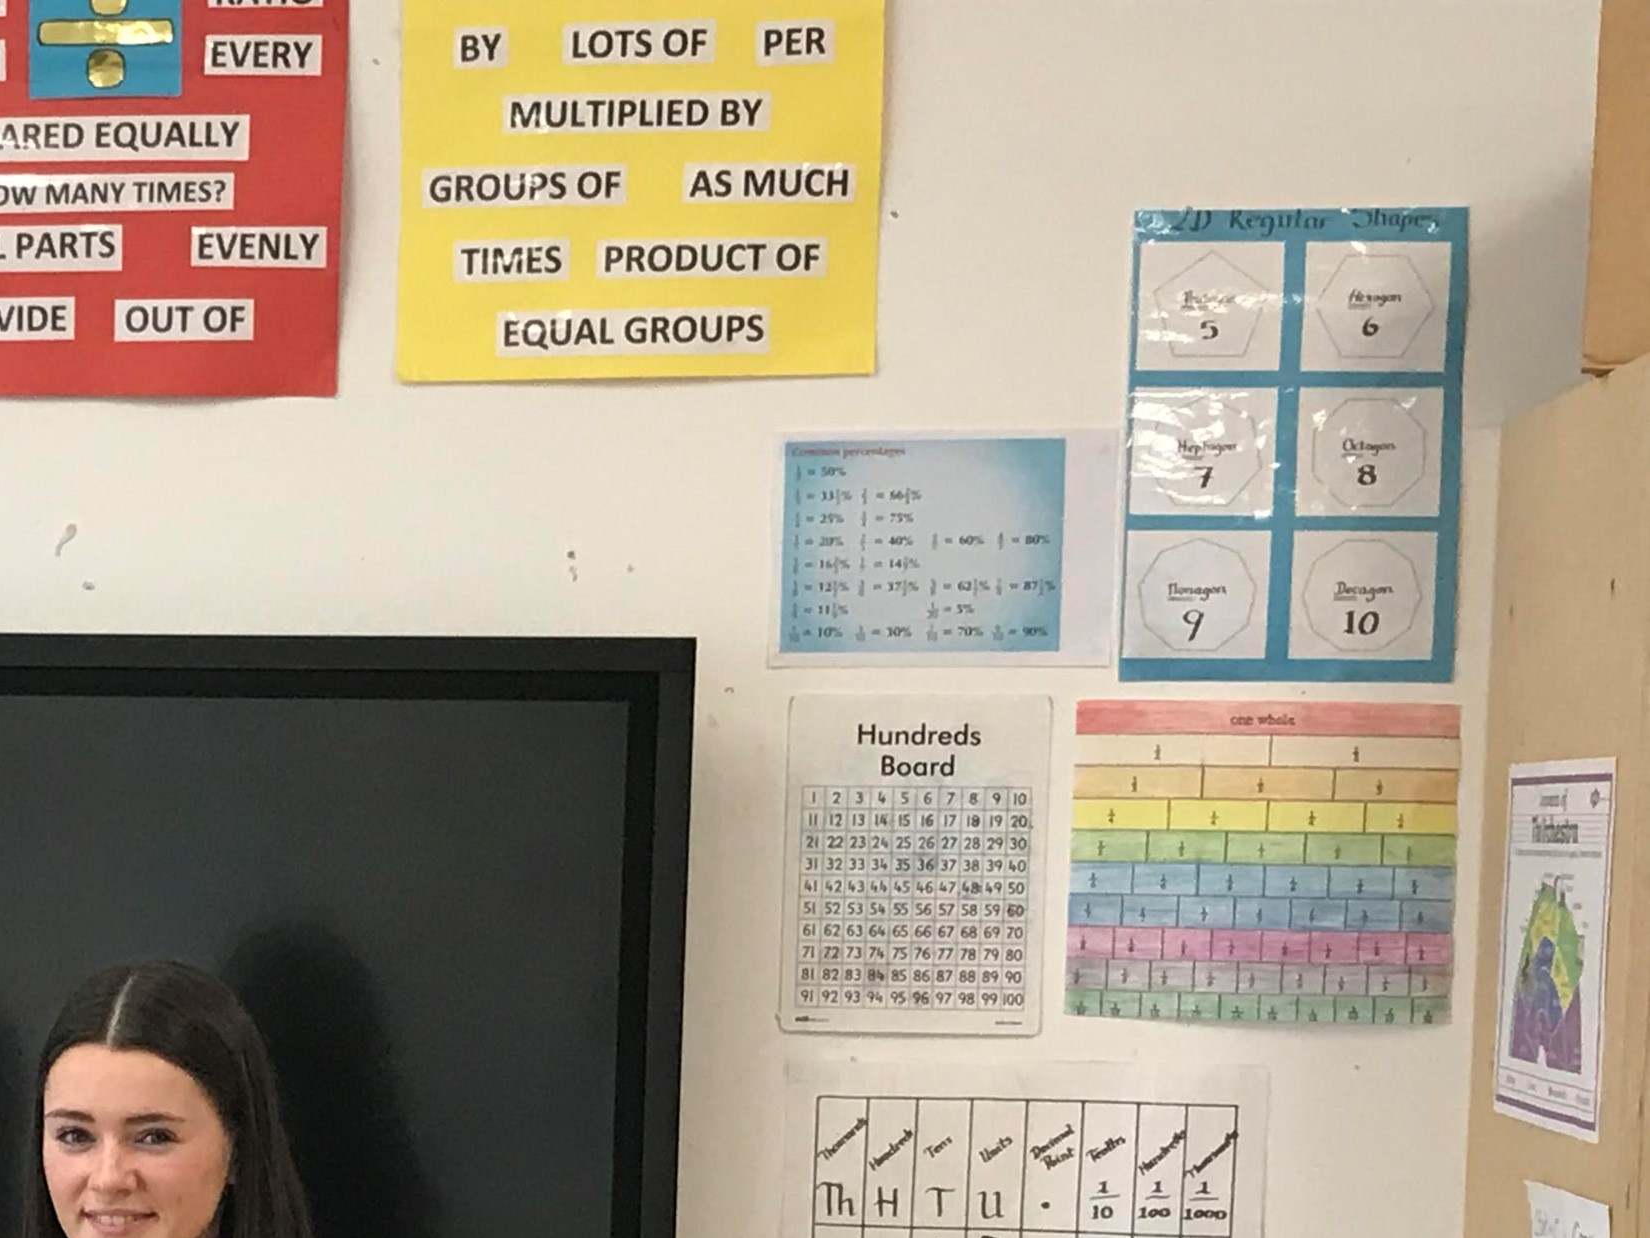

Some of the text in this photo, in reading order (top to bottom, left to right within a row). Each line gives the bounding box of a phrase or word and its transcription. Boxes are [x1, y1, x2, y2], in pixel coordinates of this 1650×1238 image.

[460, 33, 502, 62] BY
[571, 29, 707, 59] LOTS OF
[763, 27, 826, 55] PER
[210, 41, 313, 69] EVERY
[509, 98, 763, 128] MULTIPLIED BY
[94, 120, 240, 152] EQUALLY
[45, 183, 126, 205] MANY
[133, 180, 226, 202] TIMES?
[429, 172, 621, 202] GROUPS OF
[689, 170, 849, 197] AS MUCH
[1172, 206, 1212, 231] 2D
[1229, 209, 1330, 236] Regular
[15, 232, 116, 259] PARTS
[198, 234, 319, 260] EVENLY
[604, 244, 821, 273] PRODUCT OF
[461, 247, 562, 276] TIMES
[125, 306, 247, 333] OUT OF
[503, 315, 765, 349] EQUAL GROUPS
[1200, 320, 1219, 340] 5
[1362, 316, 1379, 337] 6
[1342, 439, 1396, 456] Octagon
[1193, 467, 1213, 488] 7
[1357, 465, 1377, 486] 8
[1182, 610, 1205, 641] 9
[1343, 610, 1381, 635] 10
[857, 723, 982, 746] Hundreds
[880, 755, 956, 777] Board
[816, 1182, 856, 1216] Th
[874, 1187, 898, 1217] H
[925, 1187, 956, 1217] T
[977, 1191, 1004, 1219] U
[1092, 1206, 1113, 1219] 10
[1138, 1207, 1171, 1219] 100
[1183, 1208, 1227, 1220] 1000
